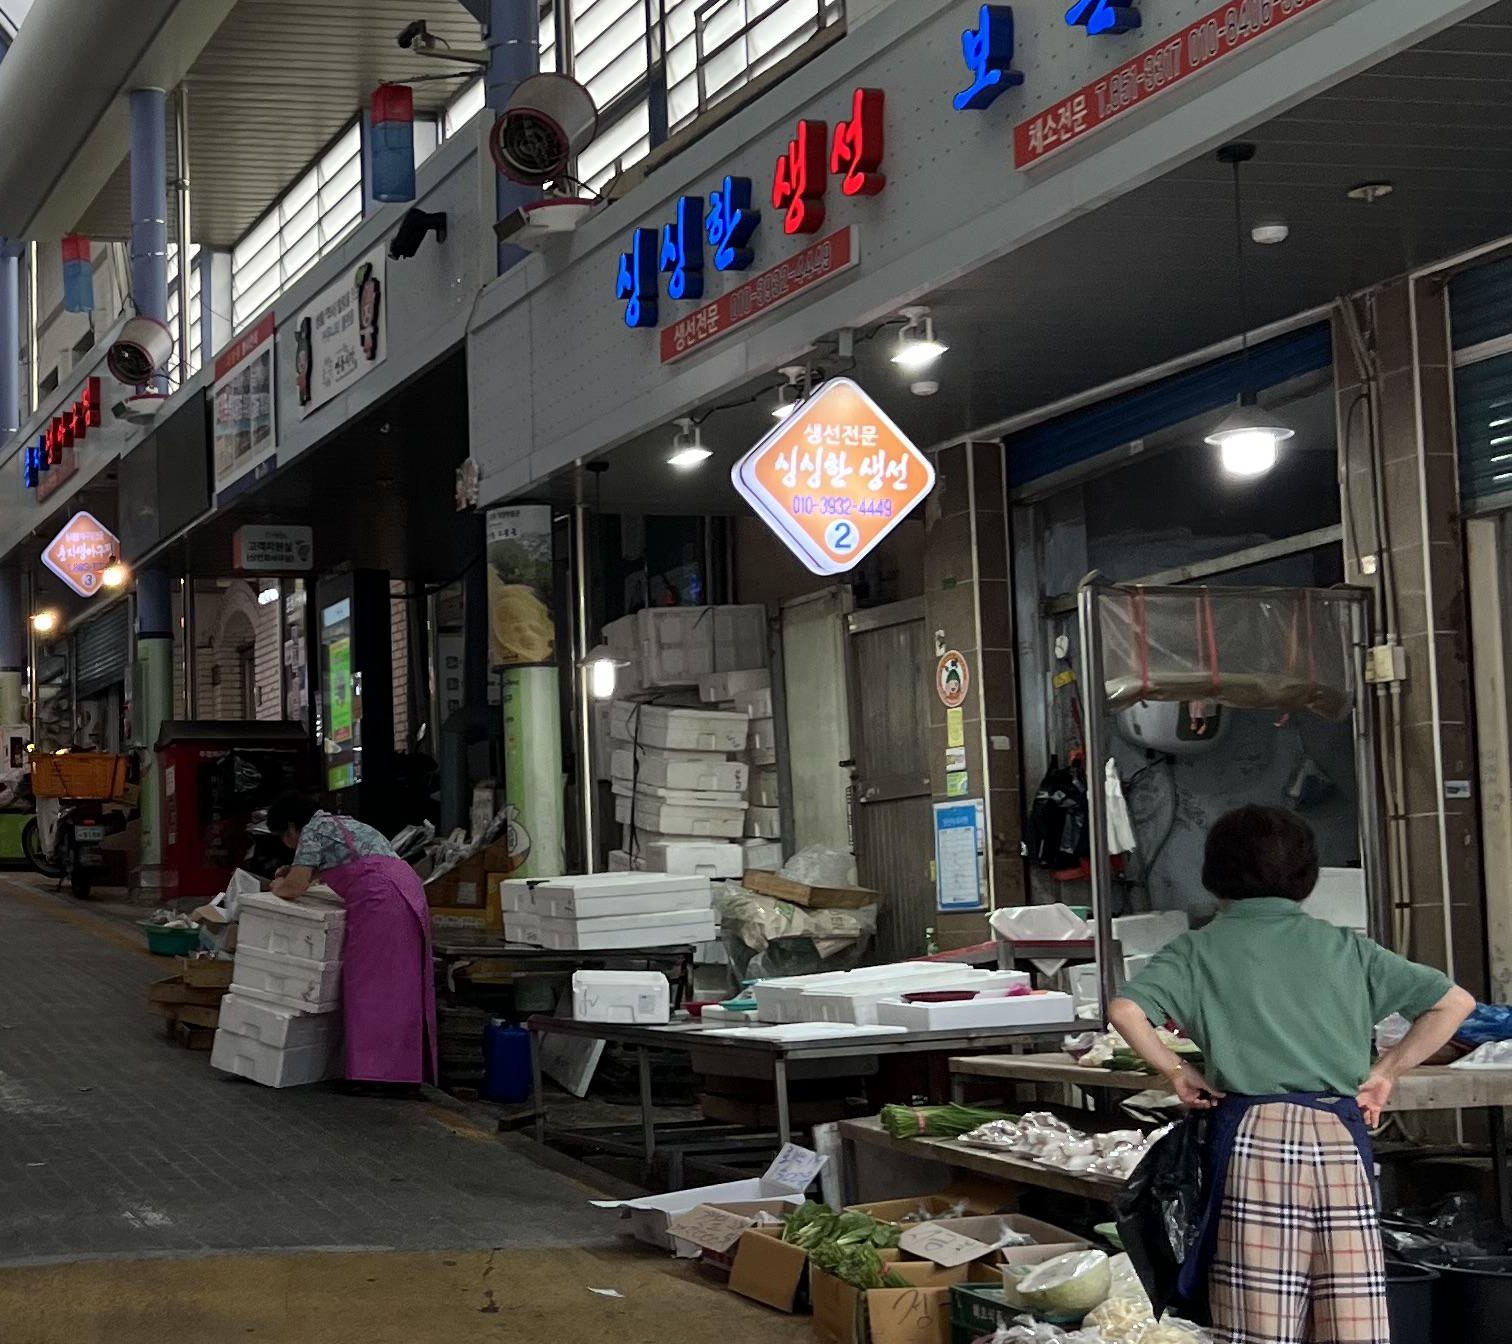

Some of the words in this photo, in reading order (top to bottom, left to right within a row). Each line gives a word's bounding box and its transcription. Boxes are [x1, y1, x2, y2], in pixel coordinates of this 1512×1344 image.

[1028, 93, 1088, 154] 채소전문
[616, 175, 760, 328] 싱싱한
[772, 87, 885, 234] 생선
[673, 304, 719, 352] 생선전문
[803, 423, 880, 446] 생선전문
[774, 445, 854, 489] 싱싱한
[858, 448, 910, 492] 생선
[792, 495, 893, 517] 010-3932-4449
[834, 522, 852, 549] 2
